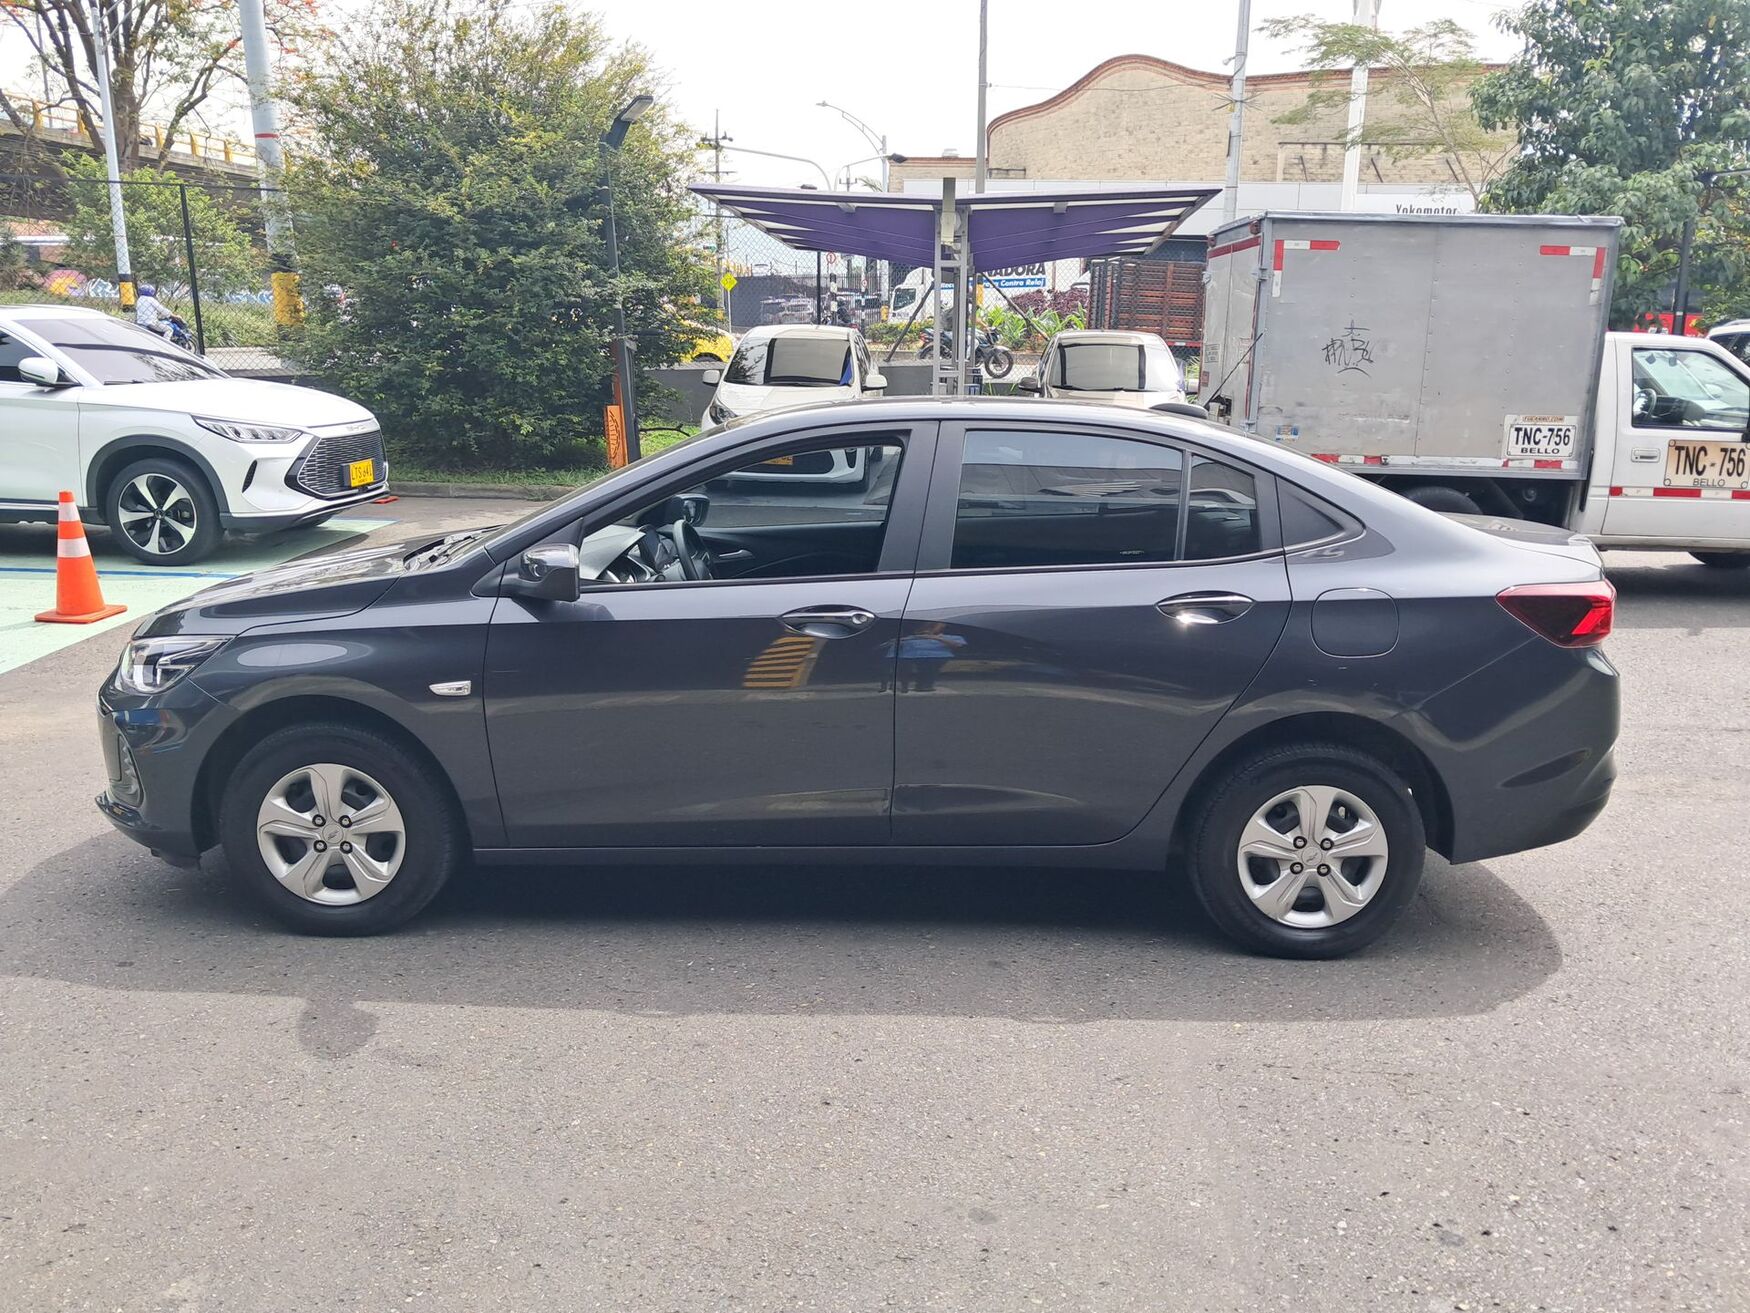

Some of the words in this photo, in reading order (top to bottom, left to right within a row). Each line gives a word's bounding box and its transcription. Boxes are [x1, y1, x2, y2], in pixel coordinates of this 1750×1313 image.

[1395, 203, 1458, 215] Yokomotor
[1000, 279, 1024, 287] Contra
[1025, 278, 1044, 288] Reloj
[1514, 427, 1571, 446] TNC-756
[1520, 447, 1560, 455] BELLO
[1692, 478, 1726, 487] BELLO
